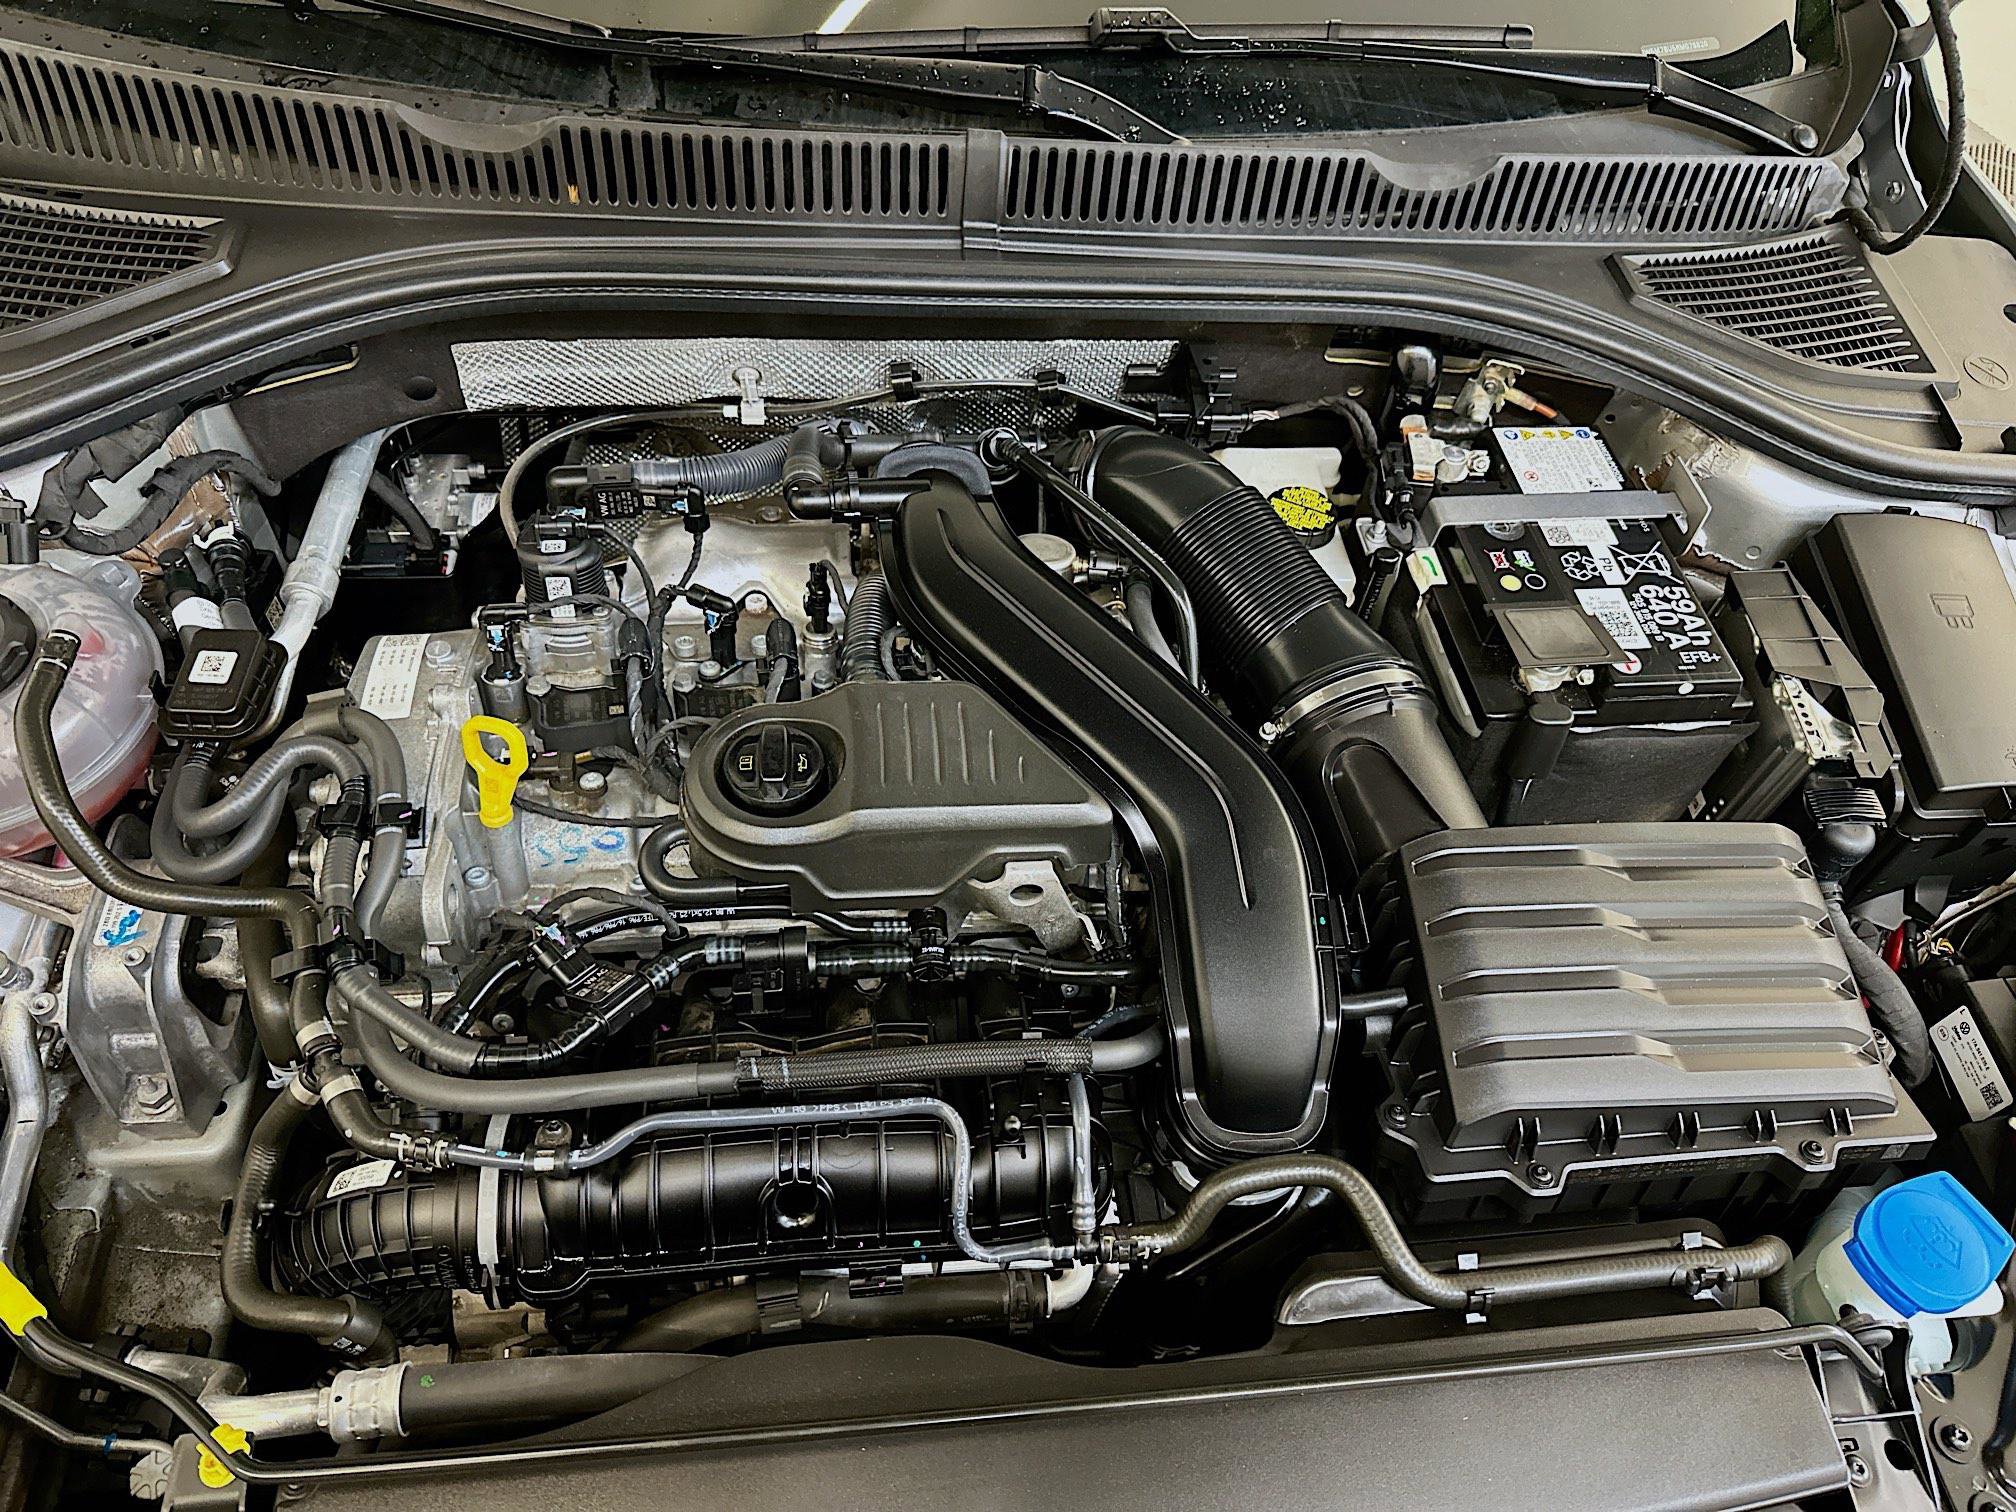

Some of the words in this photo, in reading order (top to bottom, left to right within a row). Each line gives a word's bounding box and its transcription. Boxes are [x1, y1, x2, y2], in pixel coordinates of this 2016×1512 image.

[1599, 557, 1613, 572] Pb
[1638, 584, 1680, 626] 640
[1661, 631, 1692, 650] A
[1663, 586, 1713, 646] 59Ah
[1678, 650, 1722, 664] EFB+
